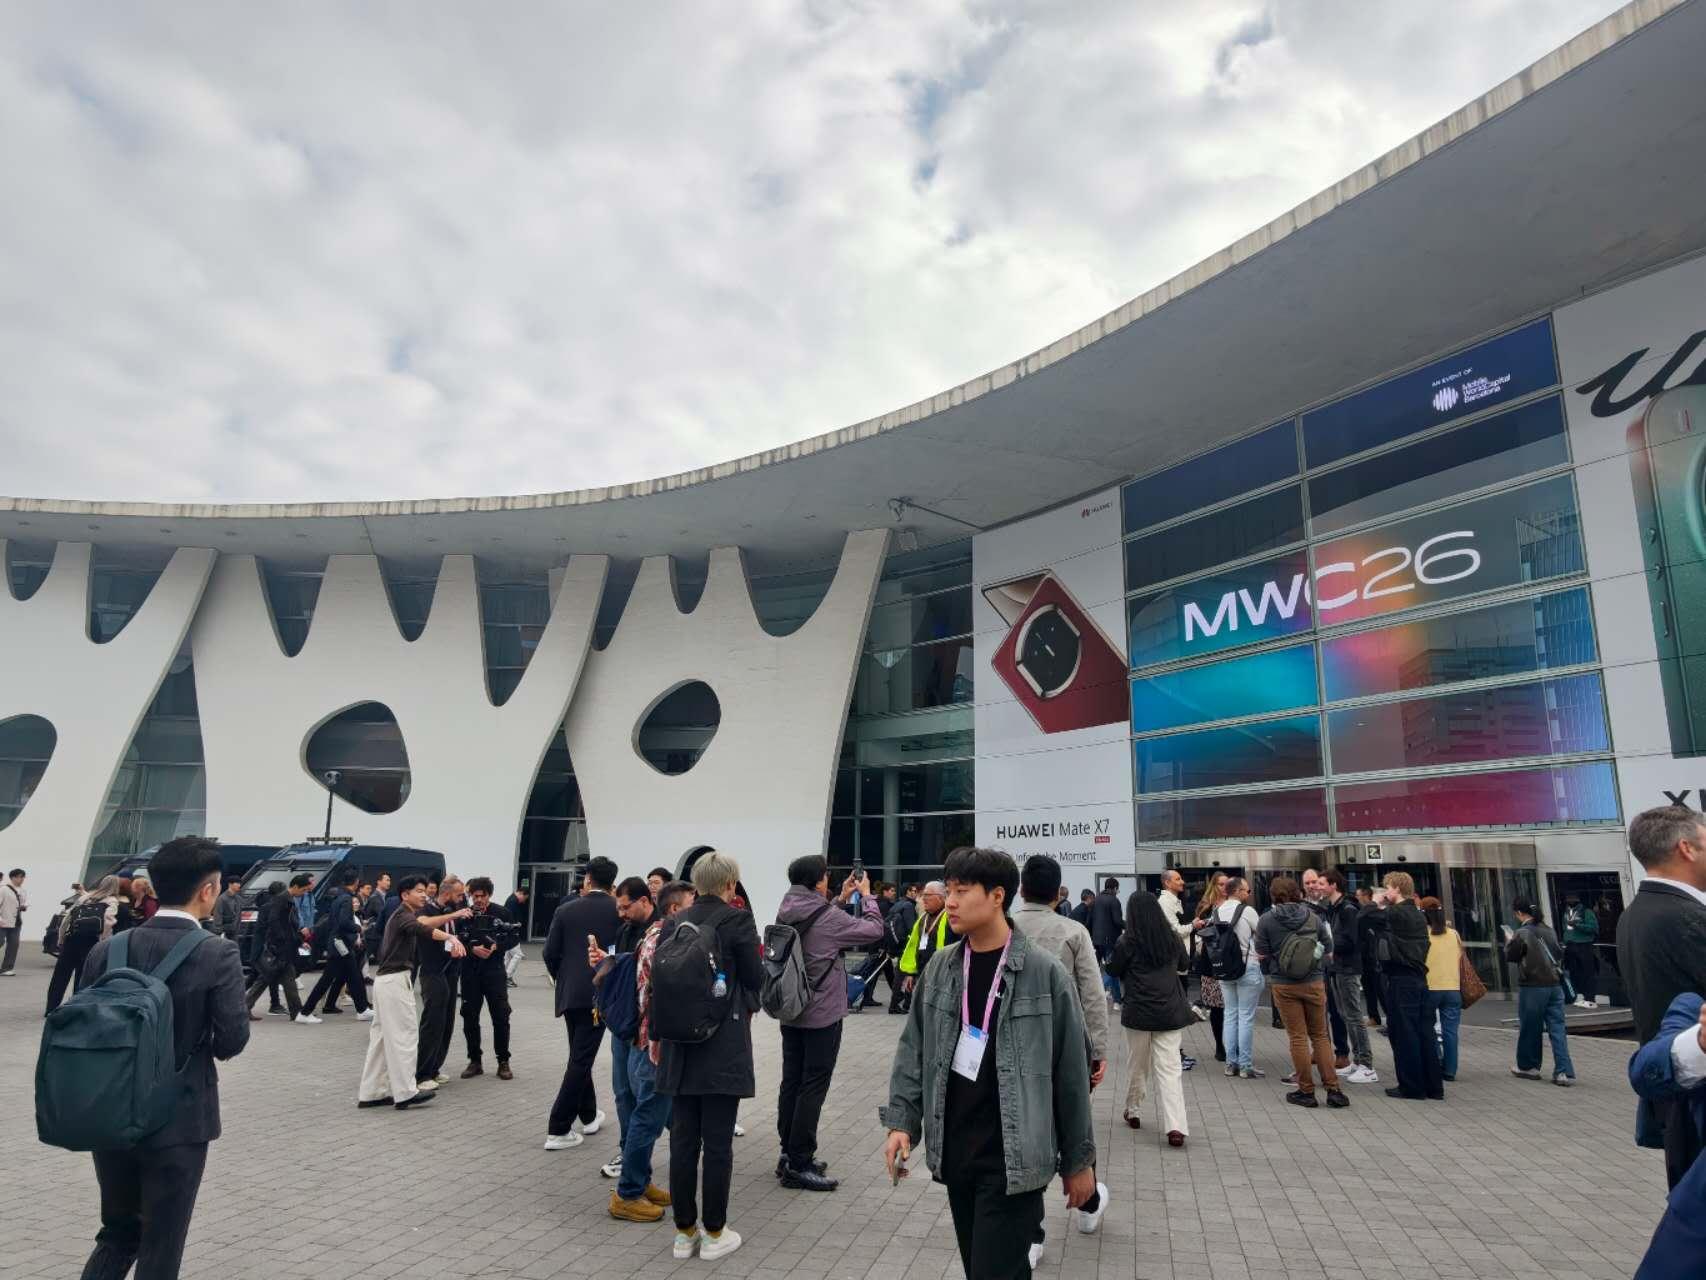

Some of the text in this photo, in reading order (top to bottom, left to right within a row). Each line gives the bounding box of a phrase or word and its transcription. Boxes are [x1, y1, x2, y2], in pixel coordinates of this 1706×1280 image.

[1183, 530, 1481, 642] MWC26
[996, 818, 1110, 839] HUAWEI Mate X7
[1060, 850, 1097, 862] Moment
